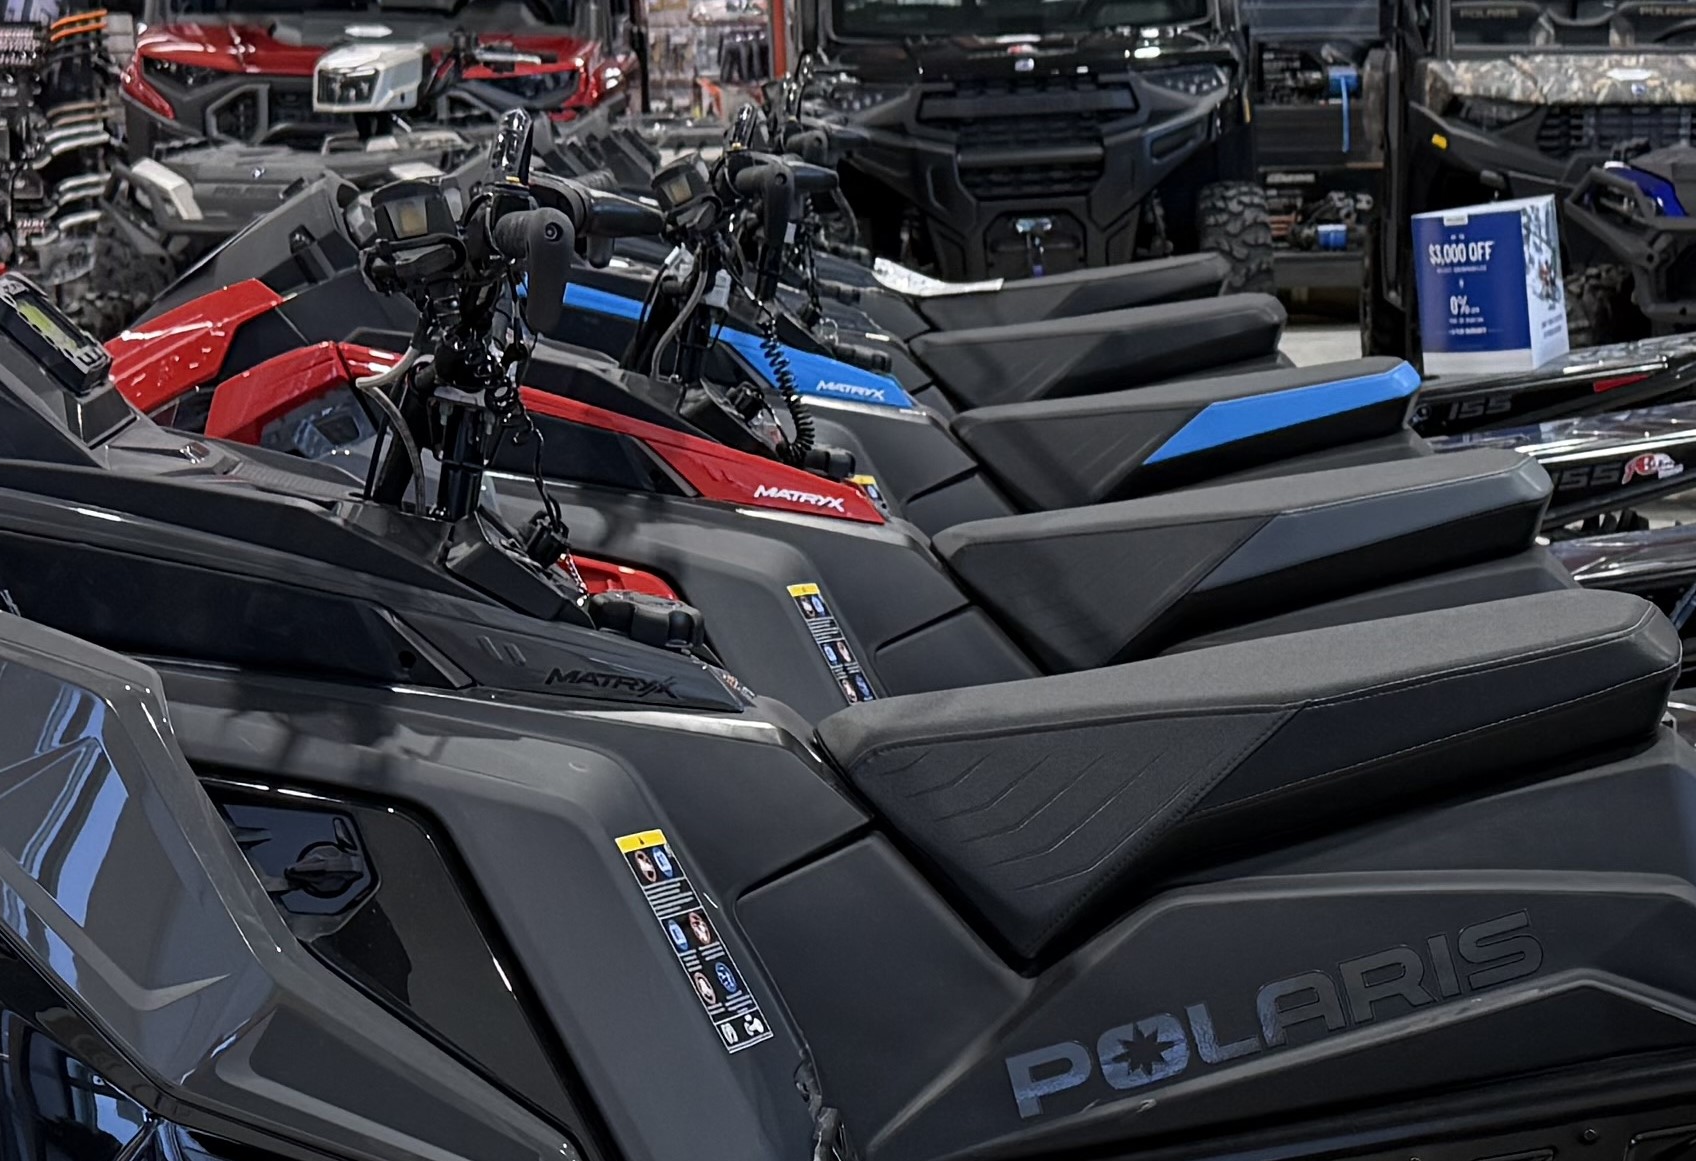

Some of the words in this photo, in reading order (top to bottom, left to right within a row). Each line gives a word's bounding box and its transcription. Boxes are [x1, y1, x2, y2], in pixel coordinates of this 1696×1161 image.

[1429, 243, 1467, 266] $3,000
[1468, 241, 1495, 262] OFF
[815, 379, 885, 402] MATRYX
[1448, 396, 1511, 421] 155
[754, 484, 846, 513] MATRYX
[544, 667, 678, 700] MATRYX
[1005, 908, 1544, 1119] POLARIS
